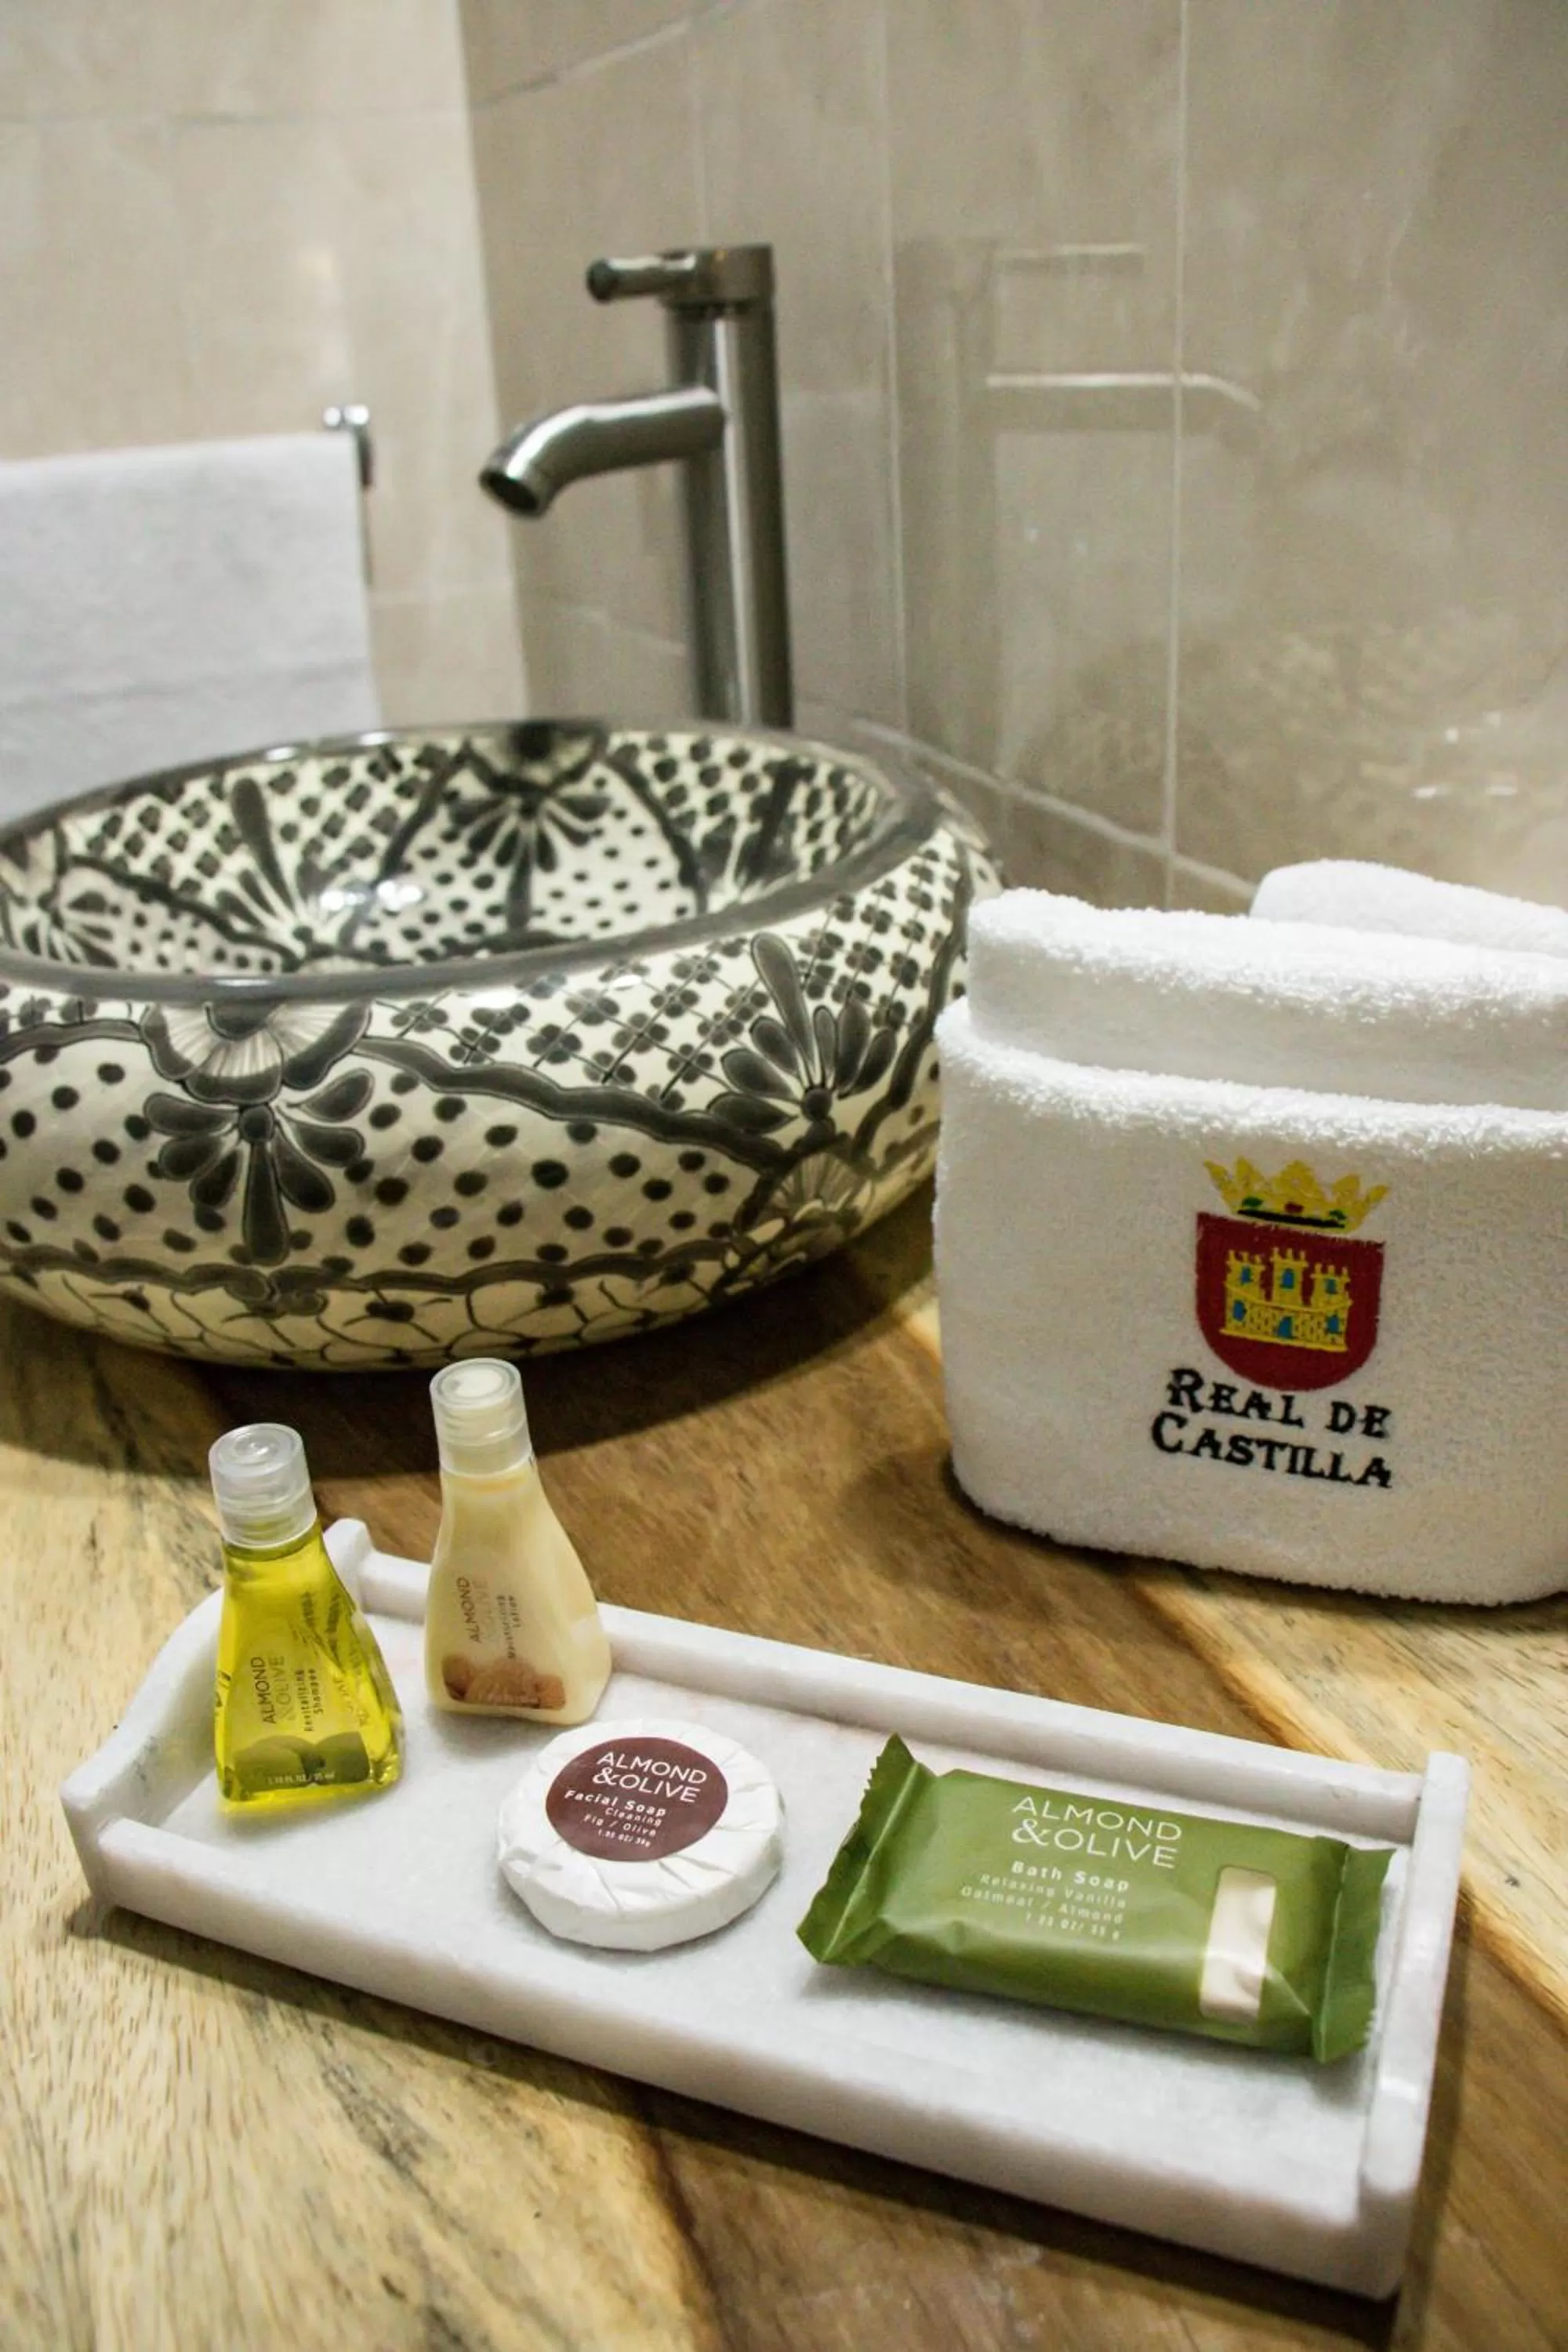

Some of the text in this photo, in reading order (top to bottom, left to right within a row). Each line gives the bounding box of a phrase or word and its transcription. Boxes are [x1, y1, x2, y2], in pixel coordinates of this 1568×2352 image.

[1167, 1367, 1392, 1439] REAL DE
[1151, 1411, 1392, 1488] CASTILLA
[456, 1576, 481, 1644] ALMOND
[250, 1656, 277, 1724] ALMOND
[592, 1766, 702, 1803] &OLIVE
[597, 1751, 707, 1784] ALMOND
[564, 1789, 666, 1817] Facial Soap
[1012, 1796, 1182, 1841] ALMOND
[623, 1823, 657, 1838] Olive
[1011, 1818, 1178, 1869] &OLIVE
[1011, 1860, 1130, 1893] Bath Soap
[1058, 1903, 1124, 1925] Almond
[1064, 1887, 1127, 1910] Vanilla
